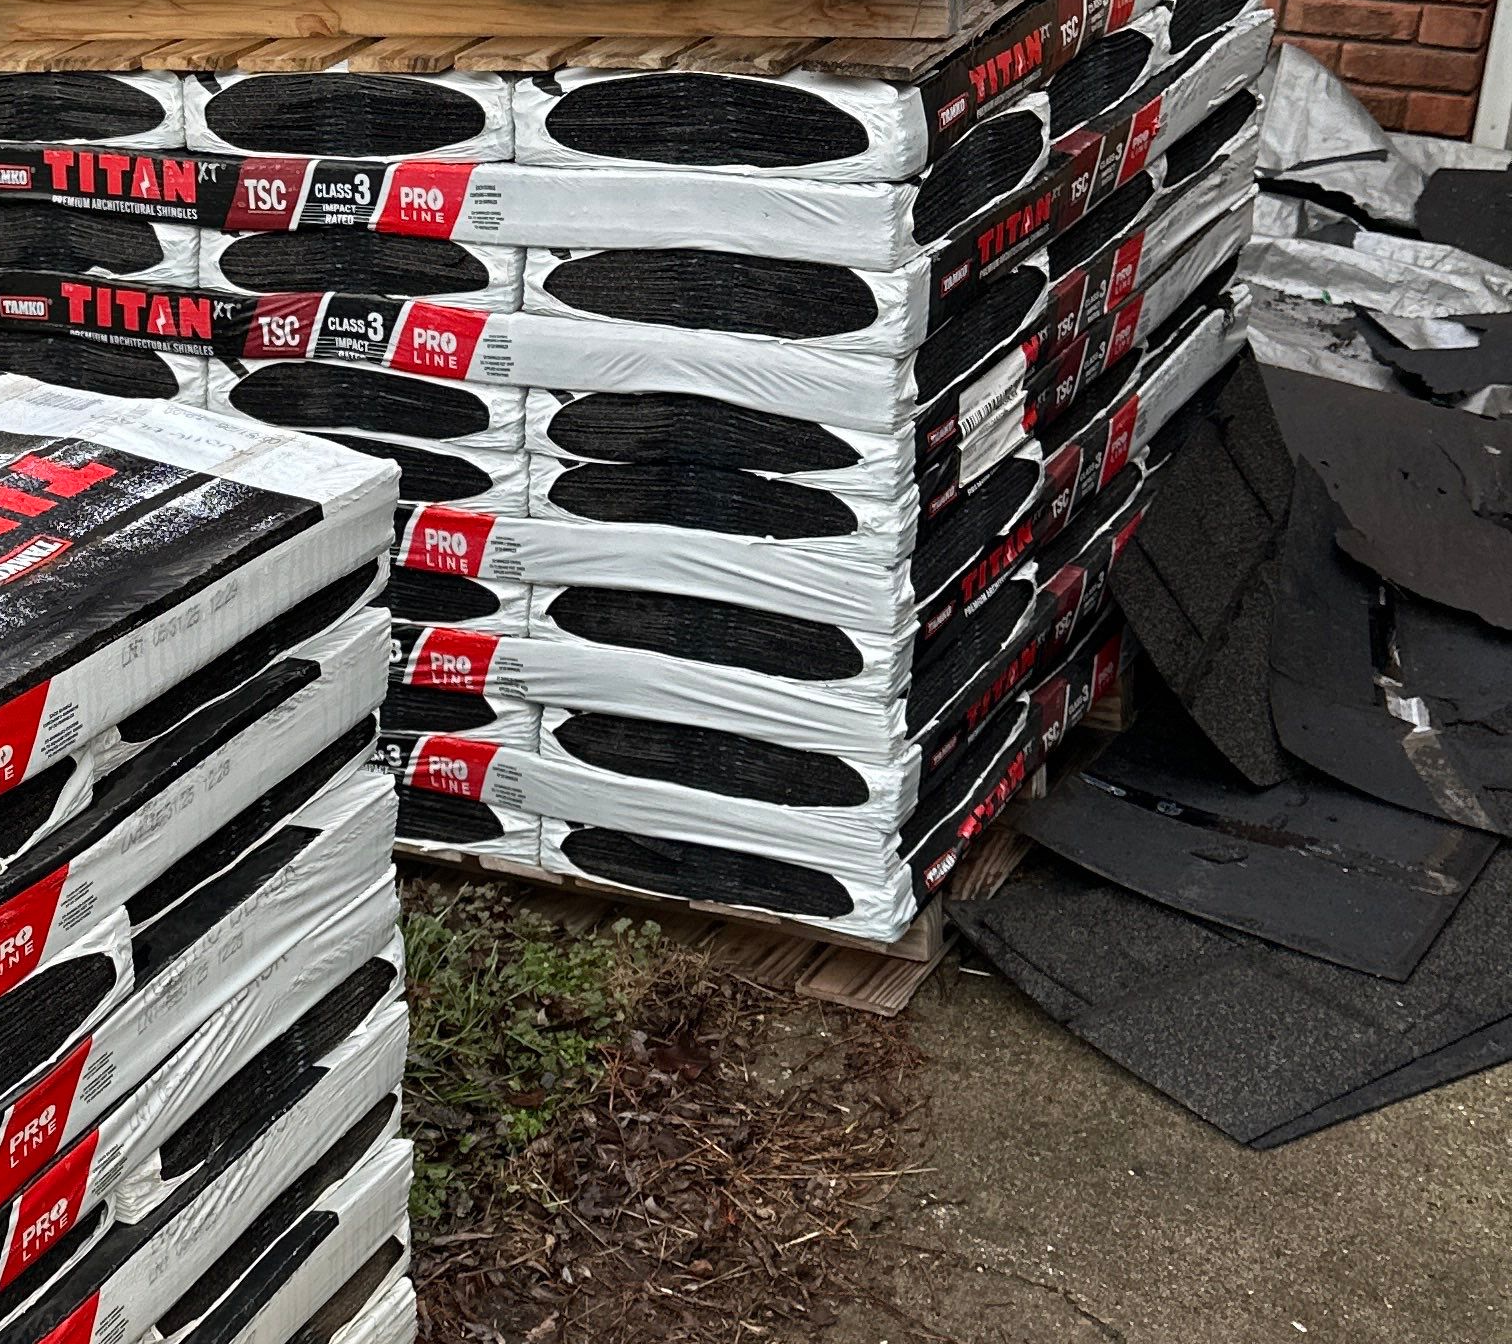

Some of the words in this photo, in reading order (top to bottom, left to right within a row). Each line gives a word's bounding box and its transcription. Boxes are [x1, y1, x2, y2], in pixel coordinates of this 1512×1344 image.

[1060, 17, 1079, 48] TSC
[969, 31, 1043, 101] TITAN
[940, 98, 967, 127] TAMKO
[44, 150, 197, 203] TITAN
[315, 183, 352, 198] CLASS
[354, 174, 370, 204] 3
[1071, 172, 1089, 202] TSC
[52, 196, 90, 208] PREMIUM
[91, 200, 156, 216] ARCHITECTURAL
[157, 207, 198, 219] SHINGLES
[244, 179, 287, 211] TSC
[323, 204, 356, 213] IMPACT
[400, 186, 444, 210] PRO
[325, 214, 354, 225] RATED
[400, 210, 444, 224] LINE
[977, 192, 1051, 264] TITAN
[3, 300, 44, 316] TAMKO
[61, 282, 211, 339] TITAN
[259, 316, 300, 347] TSC
[328, 318, 365, 333] CLASS
[367, 312, 383, 341] 3
[1058, 313, 1075, 340] TSC
[69, 329, 107, 343] PREMIUM
[109, 335, 170, 352] ARCHITECTURAL
[173, 343, 214, 357] SHINGLES
[335, 337, 369, 352] IMPACT
[413, 328, 458, 354] PRO
[414, 354, 458, 370] LINE
[1052, 488, 1070, 518] TSC
[425, 528, 468, 557] PRO
[426, 553, 469, 574] LINE
[961, 518, 1034, 604] TITAN
[430, 652, 471, 675] PRO
[432, 673, 474, 690] LINE
[428, 756, 468, 781] PRO
[430, 778, 470, 796] LINE
[10, 1103, 57, 1153] PRO
[10, 1121, 57, 1168] LINE
